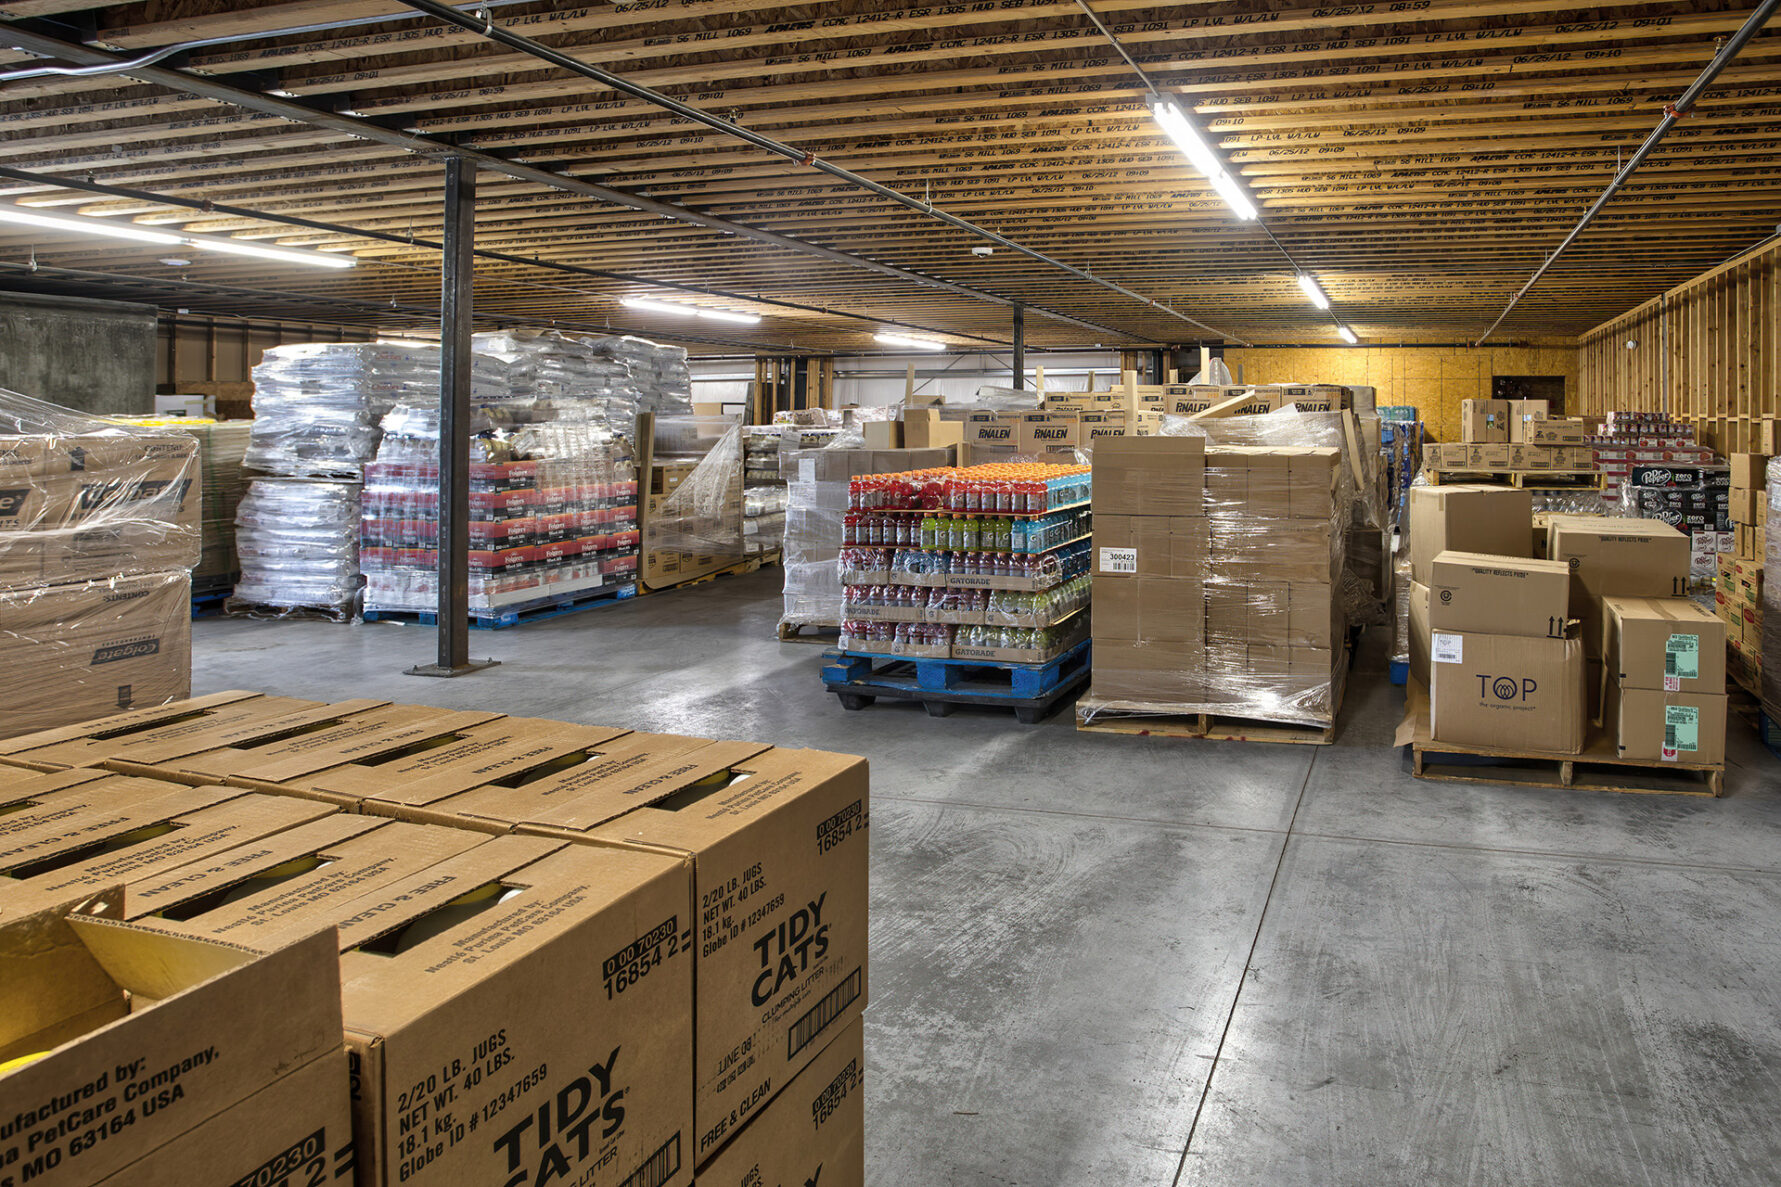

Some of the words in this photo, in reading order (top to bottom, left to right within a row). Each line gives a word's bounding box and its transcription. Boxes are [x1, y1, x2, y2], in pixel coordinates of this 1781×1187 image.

[505, 18, 520, 27] LP
[523, 15, 542, 25] LVL
[694, 30, 718, 42] MILL
[726, 27, 752, 38] 1069
[822, 16, 850, 28] CCMC
[855, 9, 904, 24] 12412-R
[909, 7, 935, 18] ESR
[937, 4, 966, 15] 1305
[972, 2, 995, 11] HUD
[846, 48, 872, 58] 1069
[940, 39, 967, 49] CCMC
[972, 34, 1019, 46] 12412-R
[1024, 32, 1046, 42] ESR
[1052, 29, 1080, 39] 1305
[1113, 24, 1135, 34] SEB
[1141, 22, 1168, 32] 1091
[1183, 20, 1199, 28] LP
[1204, 17, 1226, 27] LVL
[1234, 12, 1280, 25] W/L/LW
[1312, 5, 1375, 18] 06/25/12
[1425, 34, 1442, 43] LP
[1555, 21, 1618, 34] 06/25/12
[1633, 17, 1673, 28] 09:01
[1514, 52, 1571, 64] 06/25/12
[1110, 553, 1135, 561] 300423
[950, 577, 991, 586] GATORADE
[955, 649, 997, 657] GATORADE
[1476, 674, 1537, 701] TOP
[816, 826, 852, 856] 16854
[855, 814, 863, 832] 2
[226, 849, 274, 867] FREE
[138, 874, 209, 898] CLEAN
[248, 878, 328, 911] Manufactured
[392, 893, 412, 903] &
[414, 875, 457, 898] FREE
[702, 885, 724, 909] 2/20
[727, 878, 740, 895] LB.
[742, 862, 763, 884] JUGS
[703, 903, 720, 925] NET
[722, 896, 736, 912] WT.
[737, 887, 748, 902] 40
[750, 876, 767, 895] LBS.
[338, 901, 398, 931] CLEAN
[452, 908, 524, 947] Manufactured
[702, 921, 719, 943] 18.1
[703, 934, 727, 958] Globe
[730, 925, 739, 940] ID
[748, 893, 785, 927] 12347659
[753, 890, 828, 969] TIDY
[619, 947, 634, 967] 00
[637, 919, 675, 956] 70230
[603, 947, 662, 1000] 16854
[667, 933, 679, 958] 2
[751, 924, 829, 1008] CATS
[761, 987, 801, 1024] CLUMPING
[800, 967, 825, 994] LITTER
[115, 1056, 147, 1084] by:
[397, 1074, 437, 1113] 2/20
[443, 1060, 466, 1084] LB.
[472, 1028, 507, 1064] JUGS
[400, 1102, 429, 1135] NET
[433, 1086, 458, 1112] WT.
[463, 1070, 482, 1091] 40
[486, 1047, 515, 1077] LBS.
[27, 1096, 116, 1153] PetCare
[123, 1045, 220, 1102] Company,
[493, 1045, 622, 1174] TIDY
[701, 1119, 727, 1153] FREE
[729, 1110, 738, 1127] &
[740, 1077, 771, 1116] CLEAN
[21, 1148, 62, 1184] MO
[69, 1110, 136, 1157] 63164
[142, 1083, 185, 1118] USA
[398, 1125, 429, 1160] 18.1
[435, 1111, 457, 1136] kg.
[400, 1140, 445, 1183] Globe
[450, 1123, 465, 1148] ID
[469, 1114, 479, 1132] #
[482, 1063, 548, 1121] 12347659
